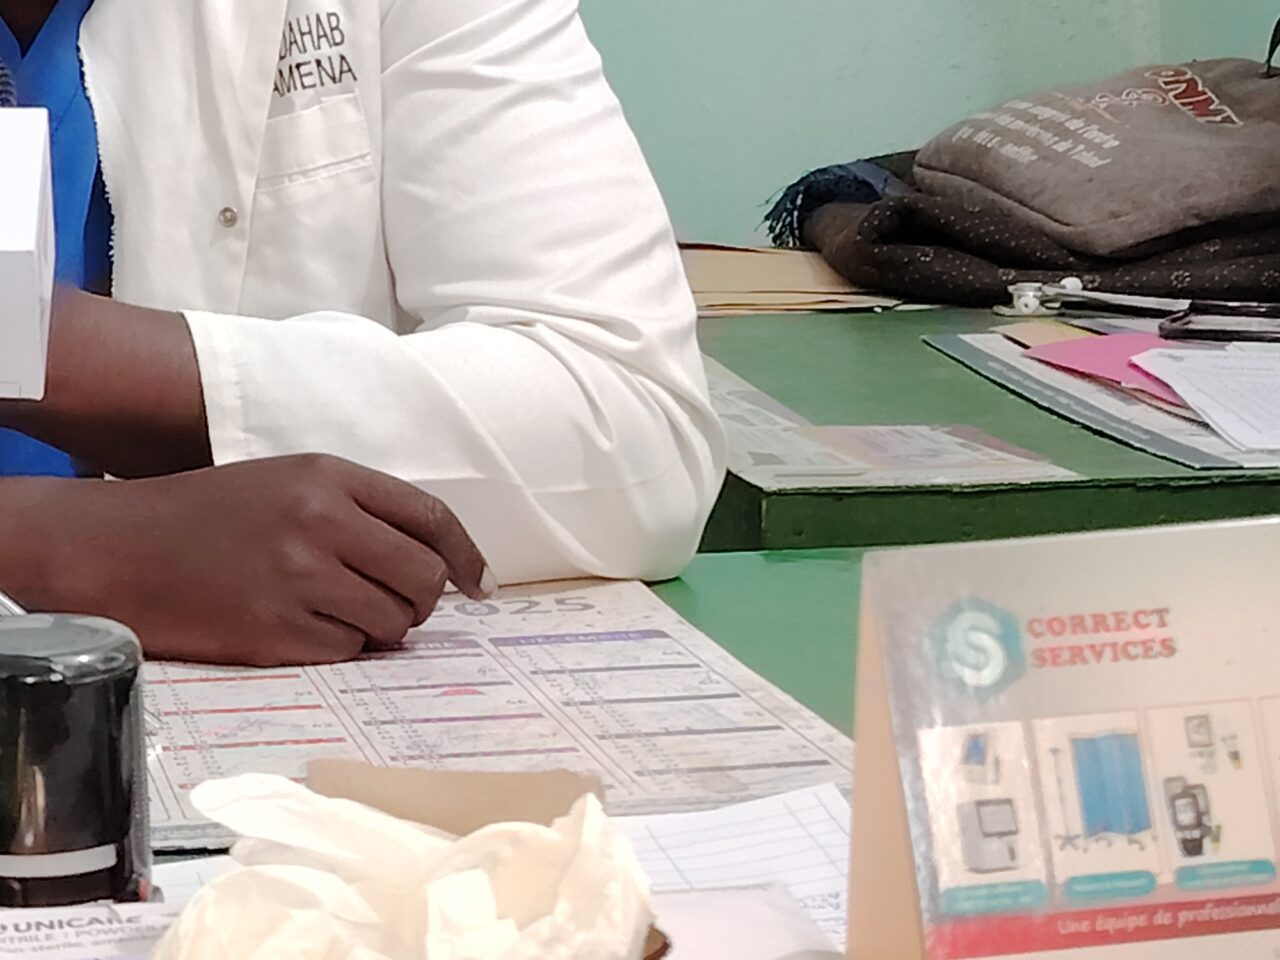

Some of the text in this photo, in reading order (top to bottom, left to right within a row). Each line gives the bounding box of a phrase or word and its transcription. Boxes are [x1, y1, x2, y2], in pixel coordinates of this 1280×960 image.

[1026, 607, 1170, 639] CORRECT
[1031, 637, 1177, 669] SERVICES
[1058, 917, 1090, 935] Une
[1096, 911, 1147, 933] équipe
[1153, 907, 1171, 925] de
